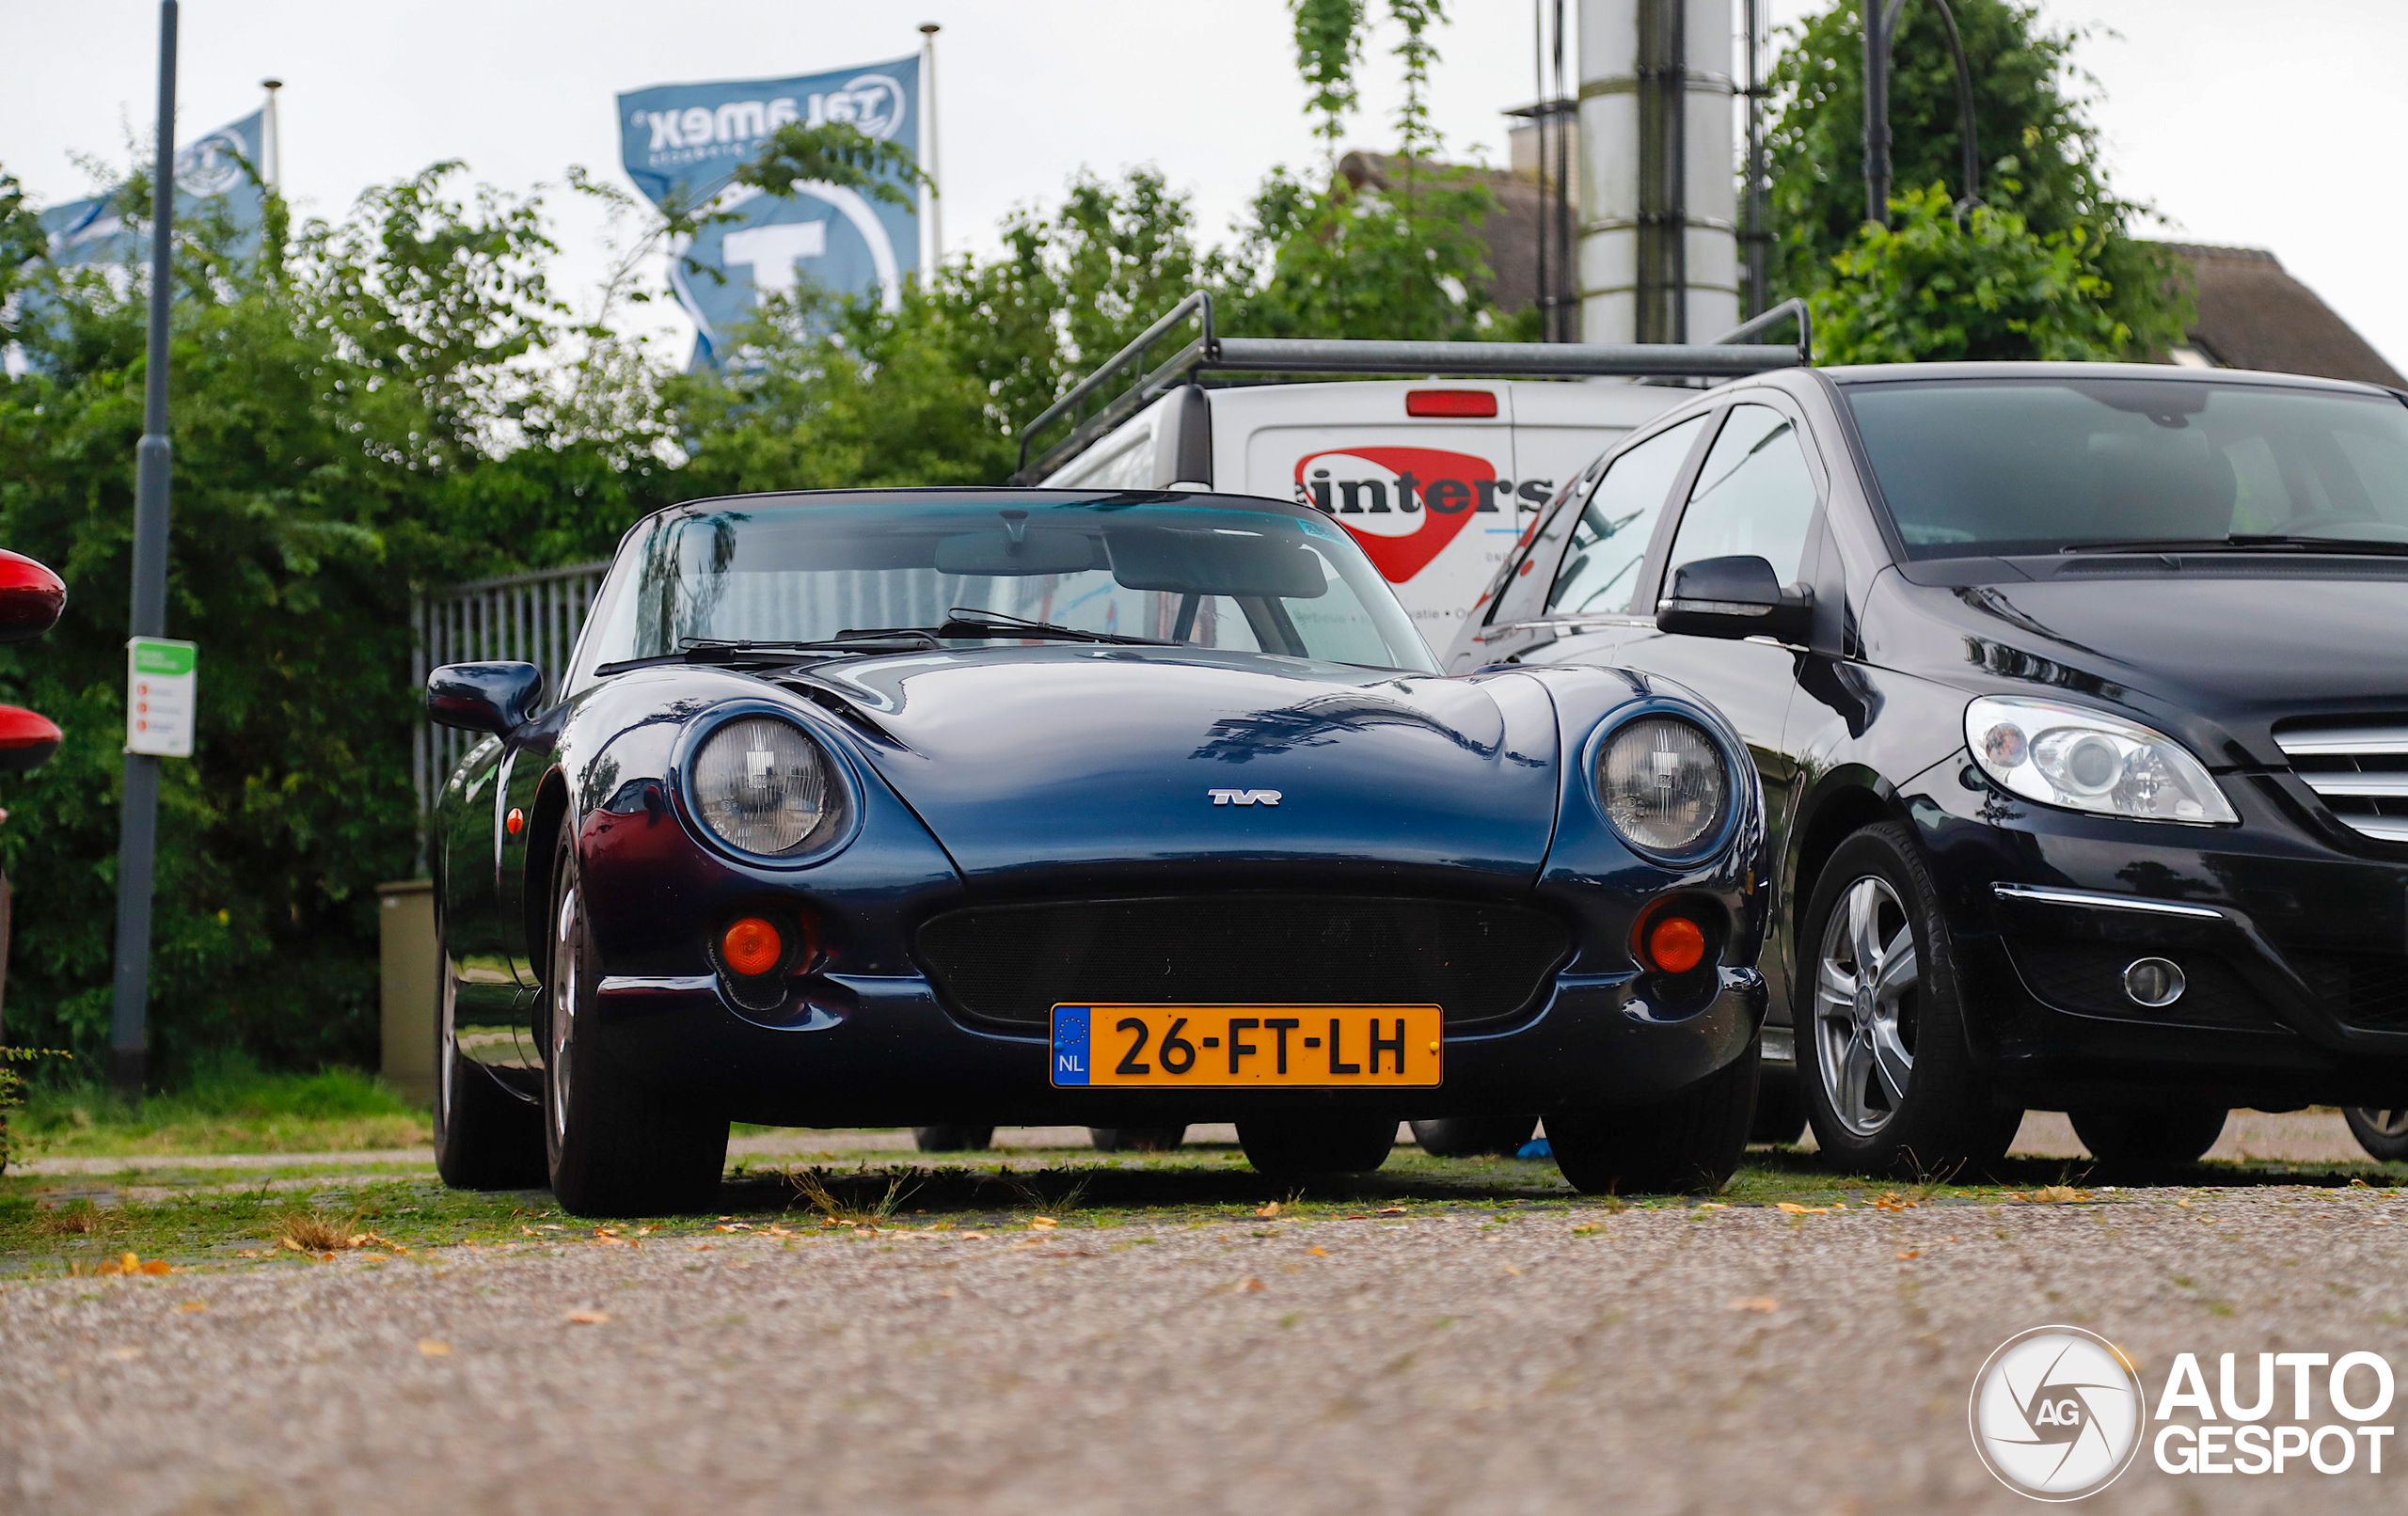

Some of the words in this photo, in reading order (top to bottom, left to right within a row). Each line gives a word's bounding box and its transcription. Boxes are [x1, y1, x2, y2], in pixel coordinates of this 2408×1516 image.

[1208, 789, 1282, 805] TVR
[1115, 1017, 1405, 1075] 26-FT-LH
[1058, 1055, 1085, 1072] NL
